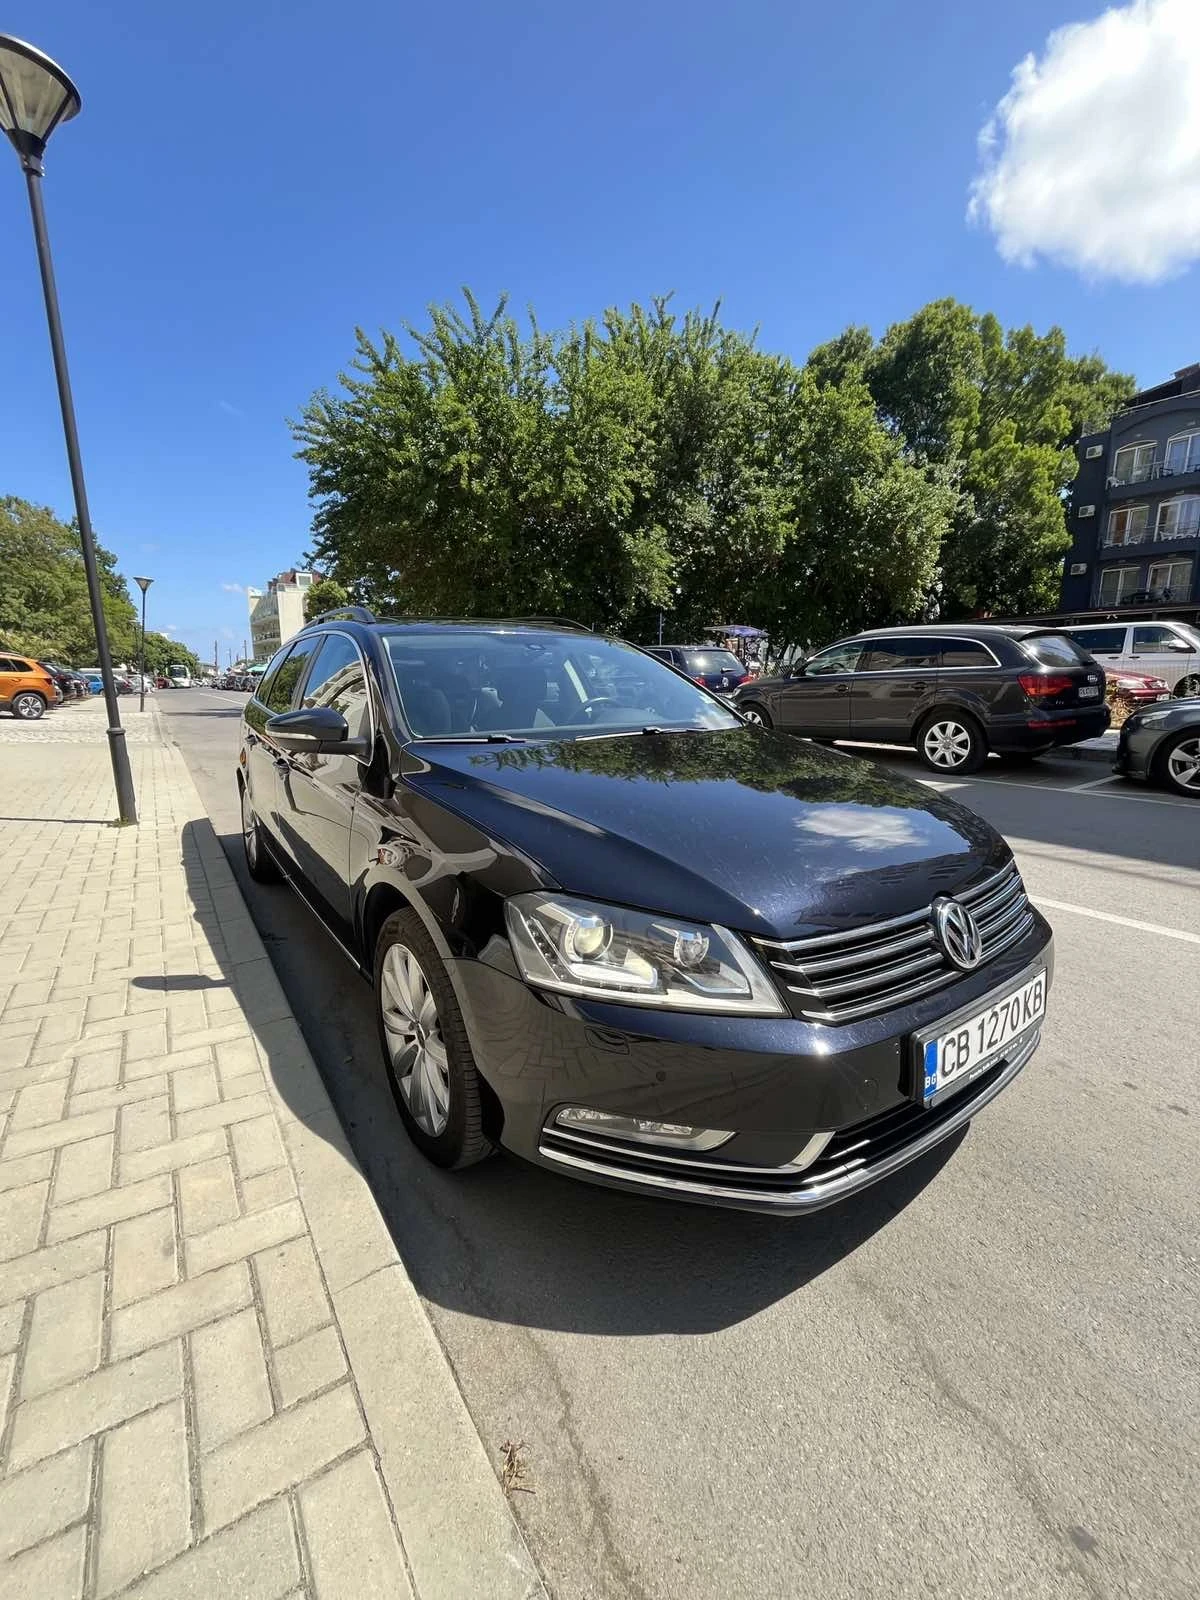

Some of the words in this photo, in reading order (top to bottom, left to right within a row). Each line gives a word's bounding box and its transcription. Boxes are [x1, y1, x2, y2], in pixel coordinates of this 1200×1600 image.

[941, 1029, 970, 1078] CB
[977, 996, 1021, 1054] 1270
[1022, 979, 1043, 1025] KB
[924, 1074, 937, 1088] BG
